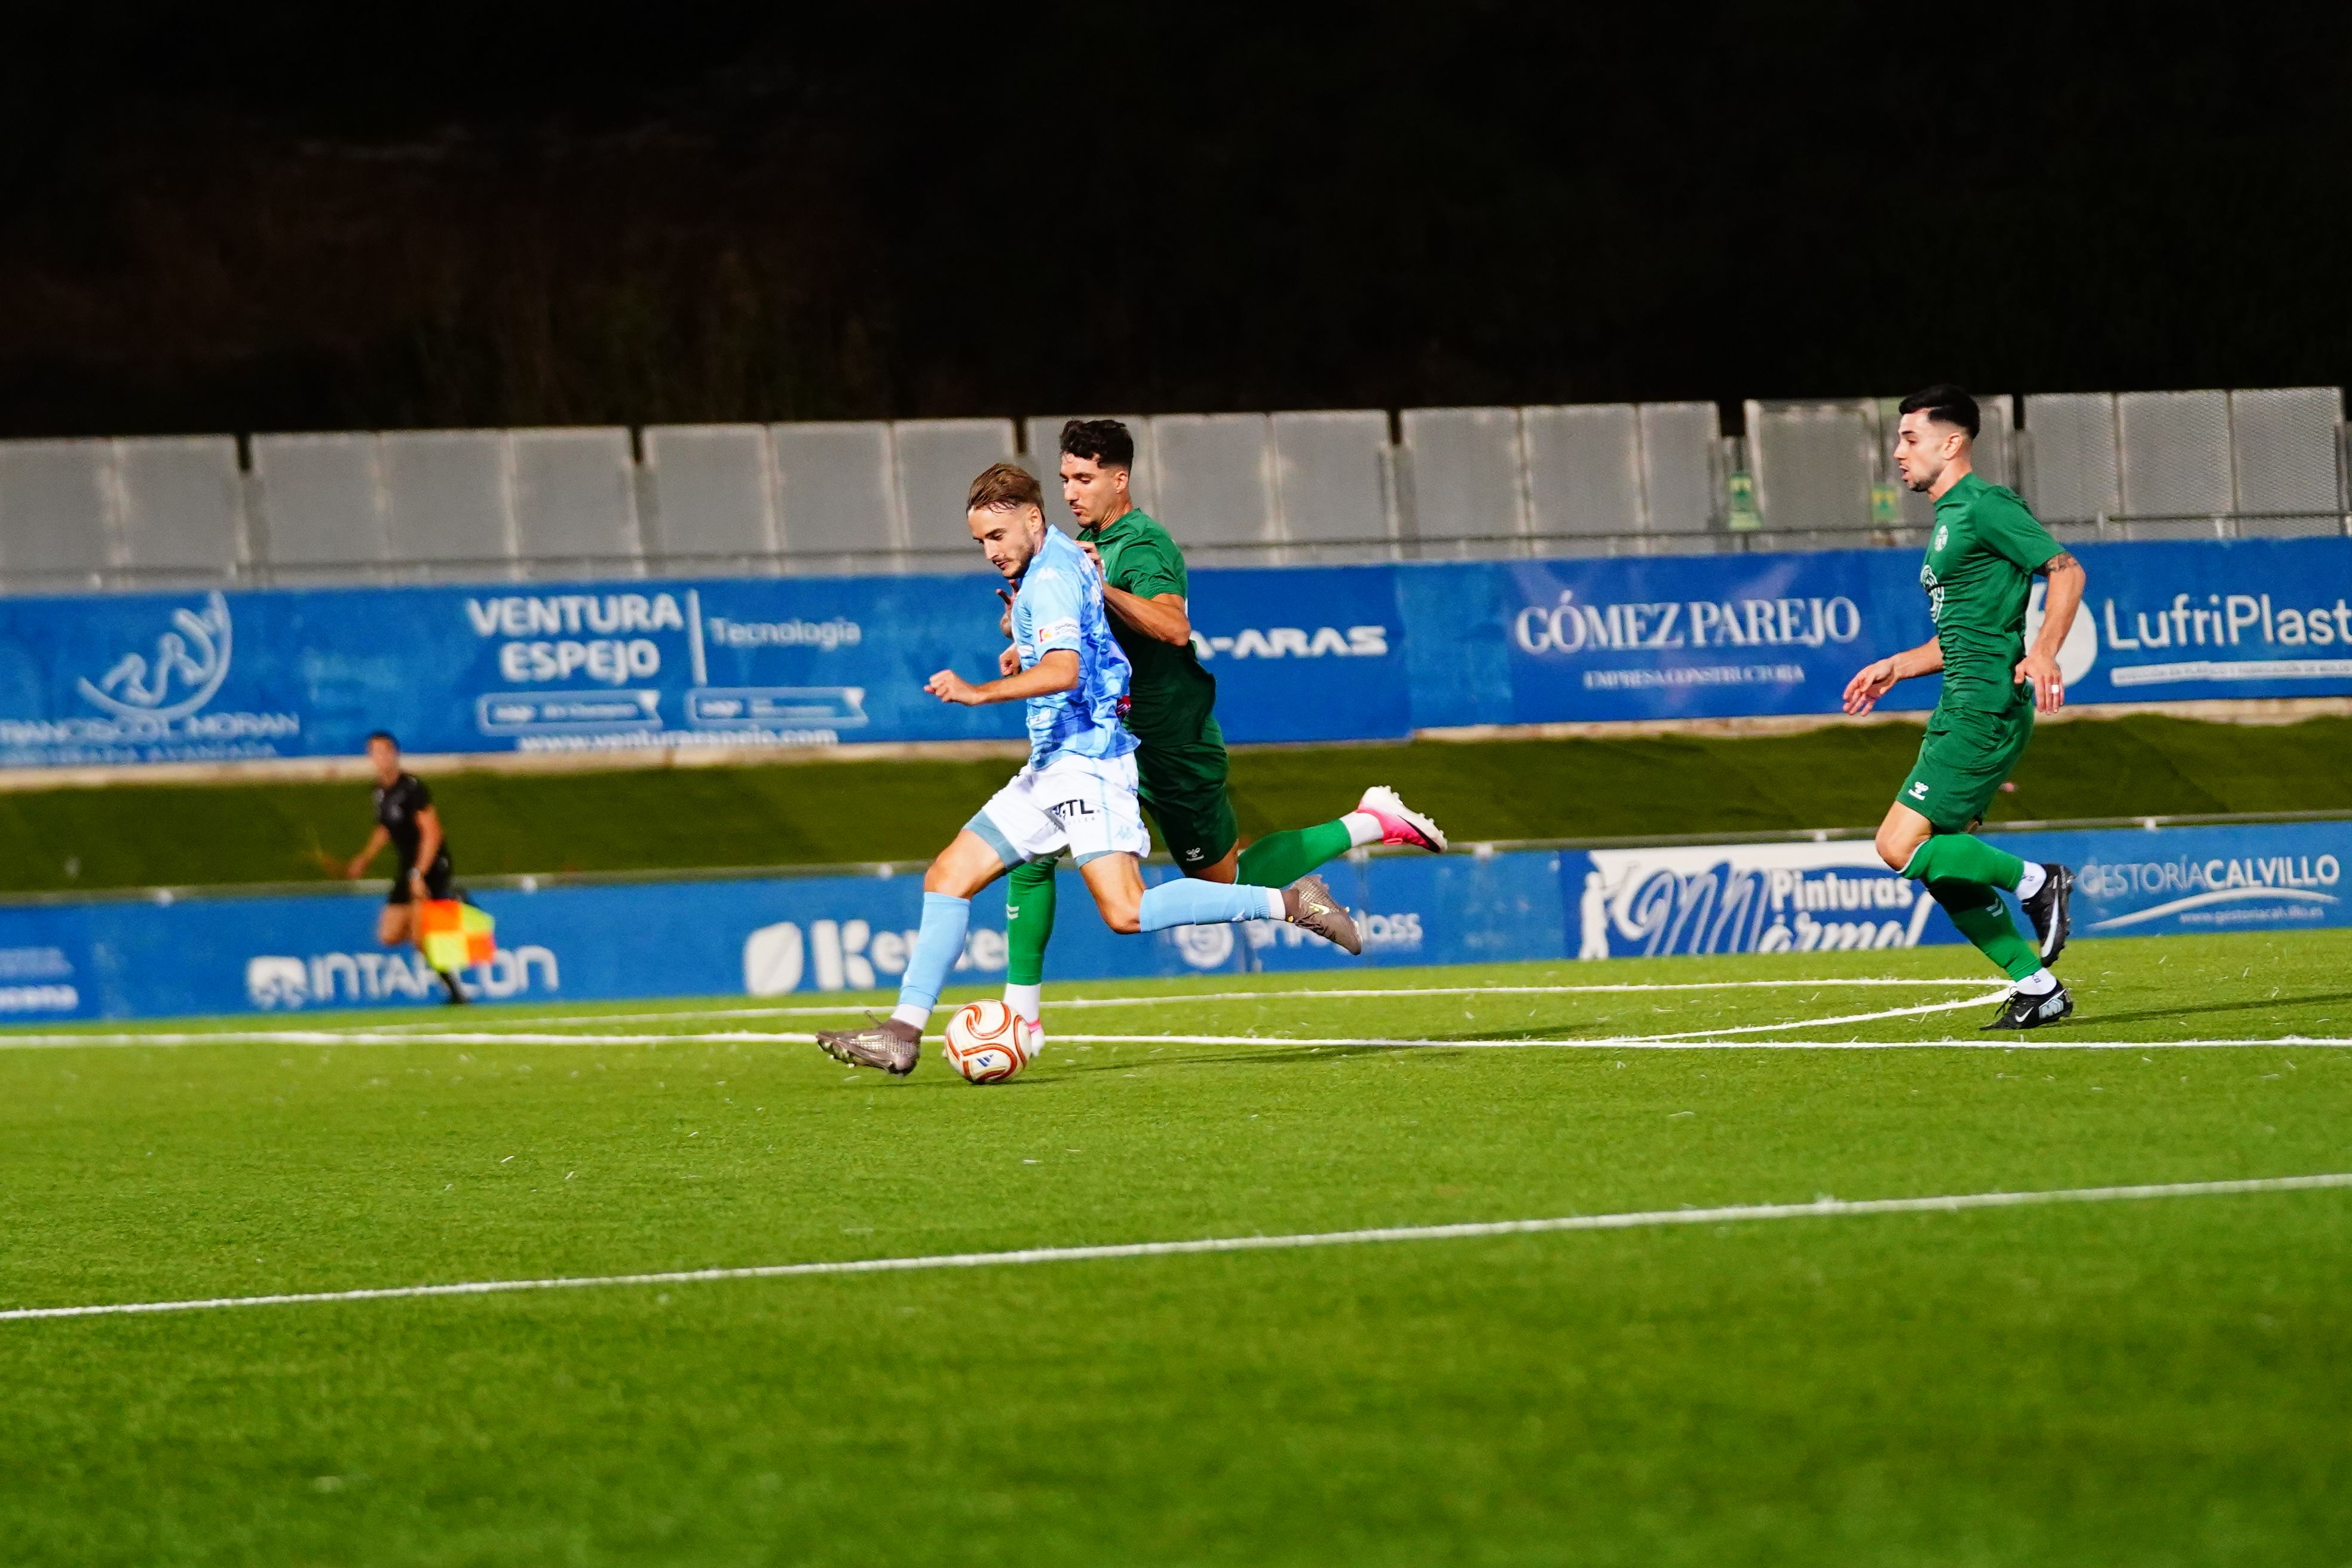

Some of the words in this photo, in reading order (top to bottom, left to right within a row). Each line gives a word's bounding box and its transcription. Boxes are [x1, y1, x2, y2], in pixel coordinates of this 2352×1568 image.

[468, 594, 683, 636] VENTURA
[1515, 590, 1683, 655] GÓMEZ
[1689, 596, 1861, 647] PAREJO
[2103, 593, 2352, 650] LufriPlast
[500, 639, 660, 684] ESPEJO
[1771, 868, 1913, 911] Pinturas
